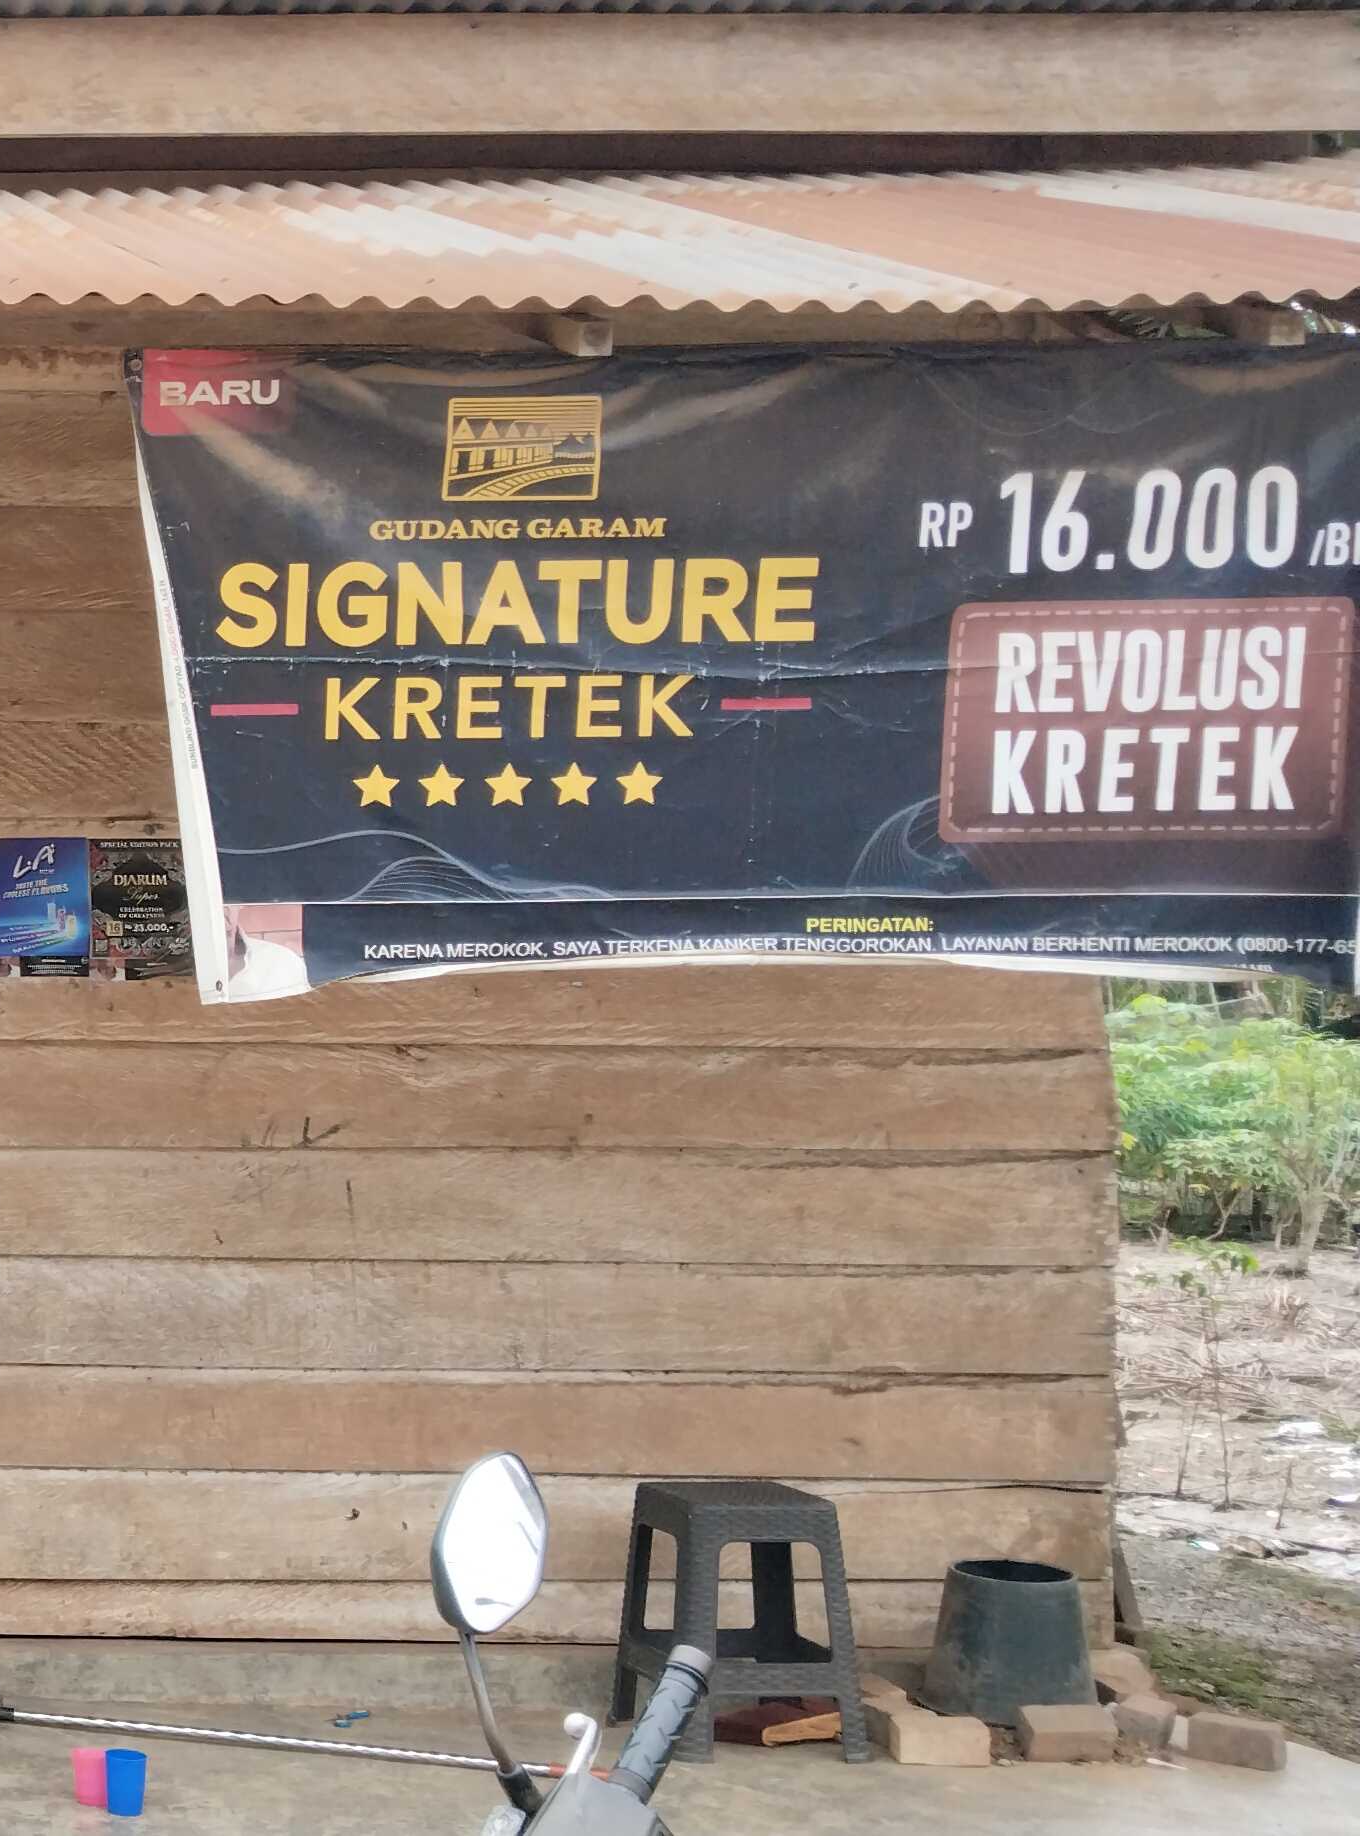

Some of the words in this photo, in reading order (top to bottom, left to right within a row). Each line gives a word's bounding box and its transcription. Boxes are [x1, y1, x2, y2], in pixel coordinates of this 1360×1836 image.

[159, 379, 281, 407] BARU
[369, 518, 522, 541] GUDANG
[526, 517, 668, 540] GARAM
[917, 502, 974, 548] RP
[999, 465, 1299, 574] 16.000
[215, 556, 820, 648] SIGNATURE
[993, 626, 1308, 713] REVOLUSI
[323, 676, 695, 741] KRETEK
[991, 726, 1300, 815] KRETEK
[113, 874, 168, 886] DJARUM
[364, 942, 442, 960] KARENA
[446, 941, 548, 960] MEROKOK,
[552, 939, 602, 957] SAYA
[603, 938, 696, 954] TERKENA
[698, 937, 778, 951] KANKER
[941, 935, 1028, 953] LAYANAN
[1032, 936, 1130, 953] BERHENTI
[1134, 936, 1232, 952] MEROKOK
[805, 916, 935, 934] PERINGATAN:
